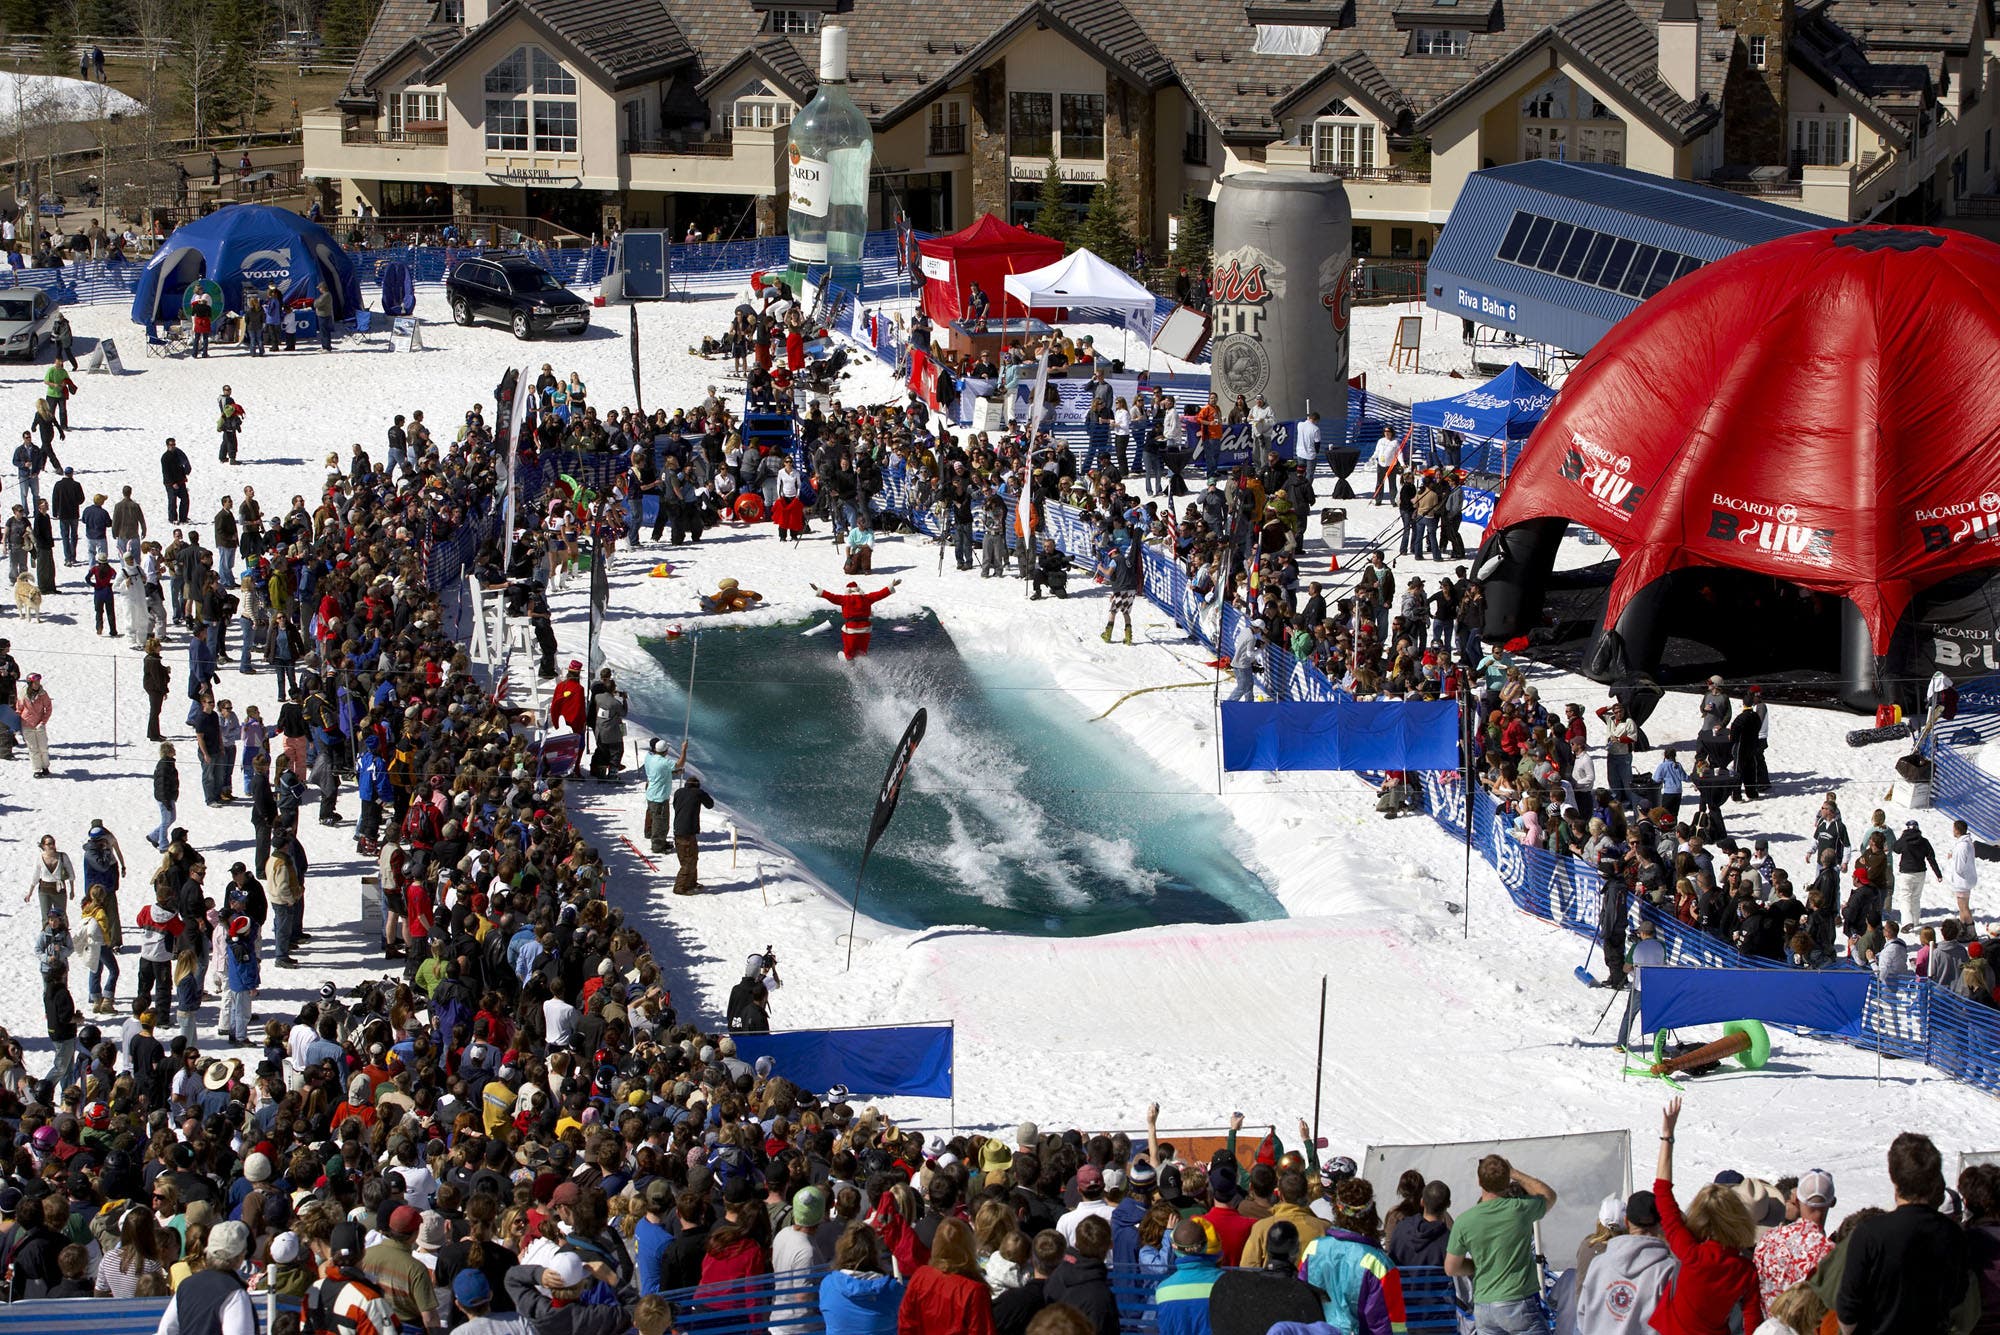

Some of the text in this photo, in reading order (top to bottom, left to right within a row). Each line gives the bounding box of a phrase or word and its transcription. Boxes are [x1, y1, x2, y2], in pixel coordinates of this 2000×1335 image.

[1014, 166, 1043, 178] GOLDEN
[1070, 168, 1095, 180] LODGE
[242, 269, 290, 279] VOLVO
[1213, 258, 1273, 306] ors
[1458, 289, 1516, 321] Riva Bahn 6
[1711, 493, 1775, 517] BACARDI
[1914, 501, 1977, 521] BACARDI
[1932, 623, 1992, 641] BACARDI
